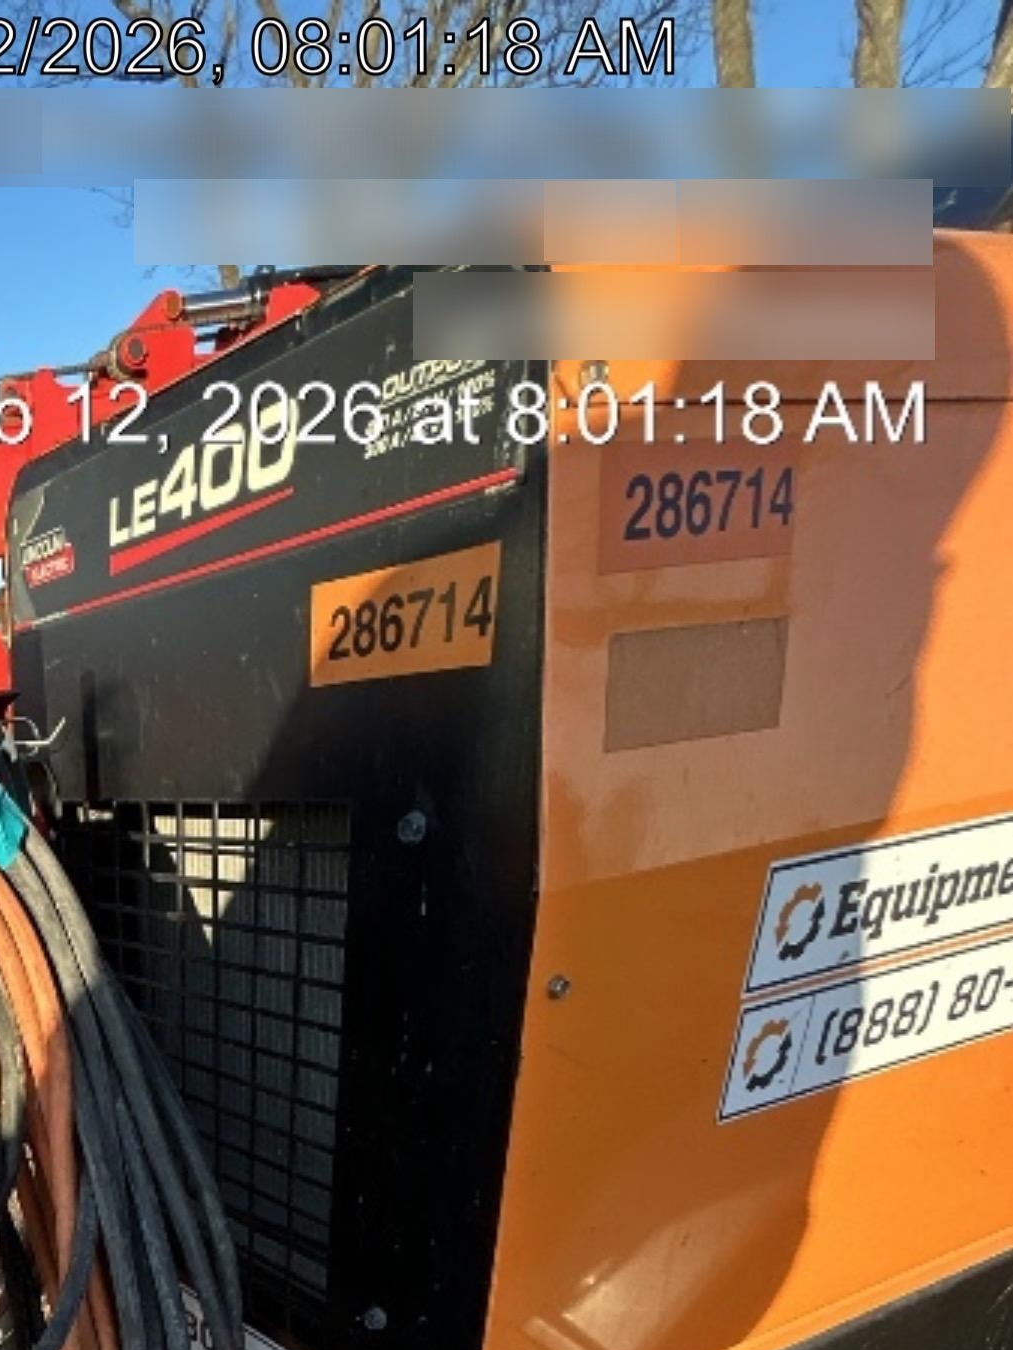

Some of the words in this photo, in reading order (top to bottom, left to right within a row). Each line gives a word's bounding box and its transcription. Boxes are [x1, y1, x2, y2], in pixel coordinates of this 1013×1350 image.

[108, 397, 300, 548] LE400
[623, 467, 795, 541] 286714
[328, 575, 494, 661] 286714
[827, 857, 1013, 941] Equipme
